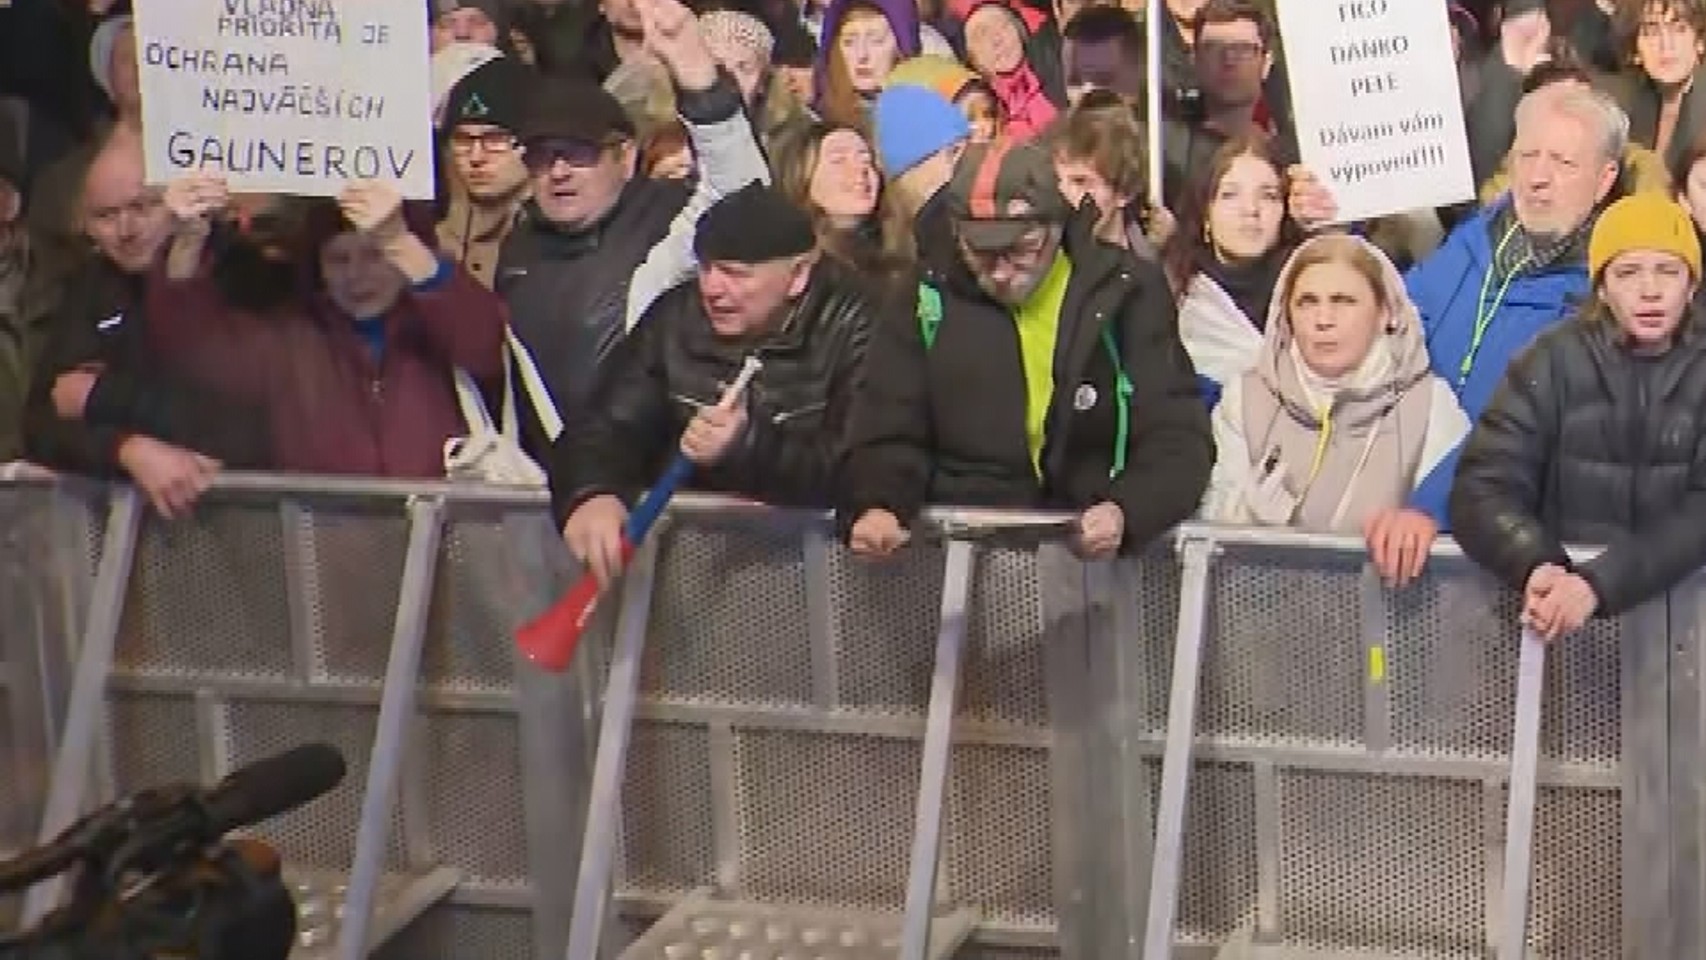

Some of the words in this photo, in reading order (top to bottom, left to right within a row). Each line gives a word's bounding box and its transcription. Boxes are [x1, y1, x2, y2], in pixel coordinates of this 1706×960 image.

[217, 14, 342, 44] PRIORITA
[361, 24, 390, 44] JE
[146, 41, 289, 76] OCHRANA
[1329, 35, 1410, 65] DANKO
[1319, 120, 1394, 147] Dávam
[1398, 110, 1444, 134] vám
[168, 130, 414, 179] GAUNEROV
